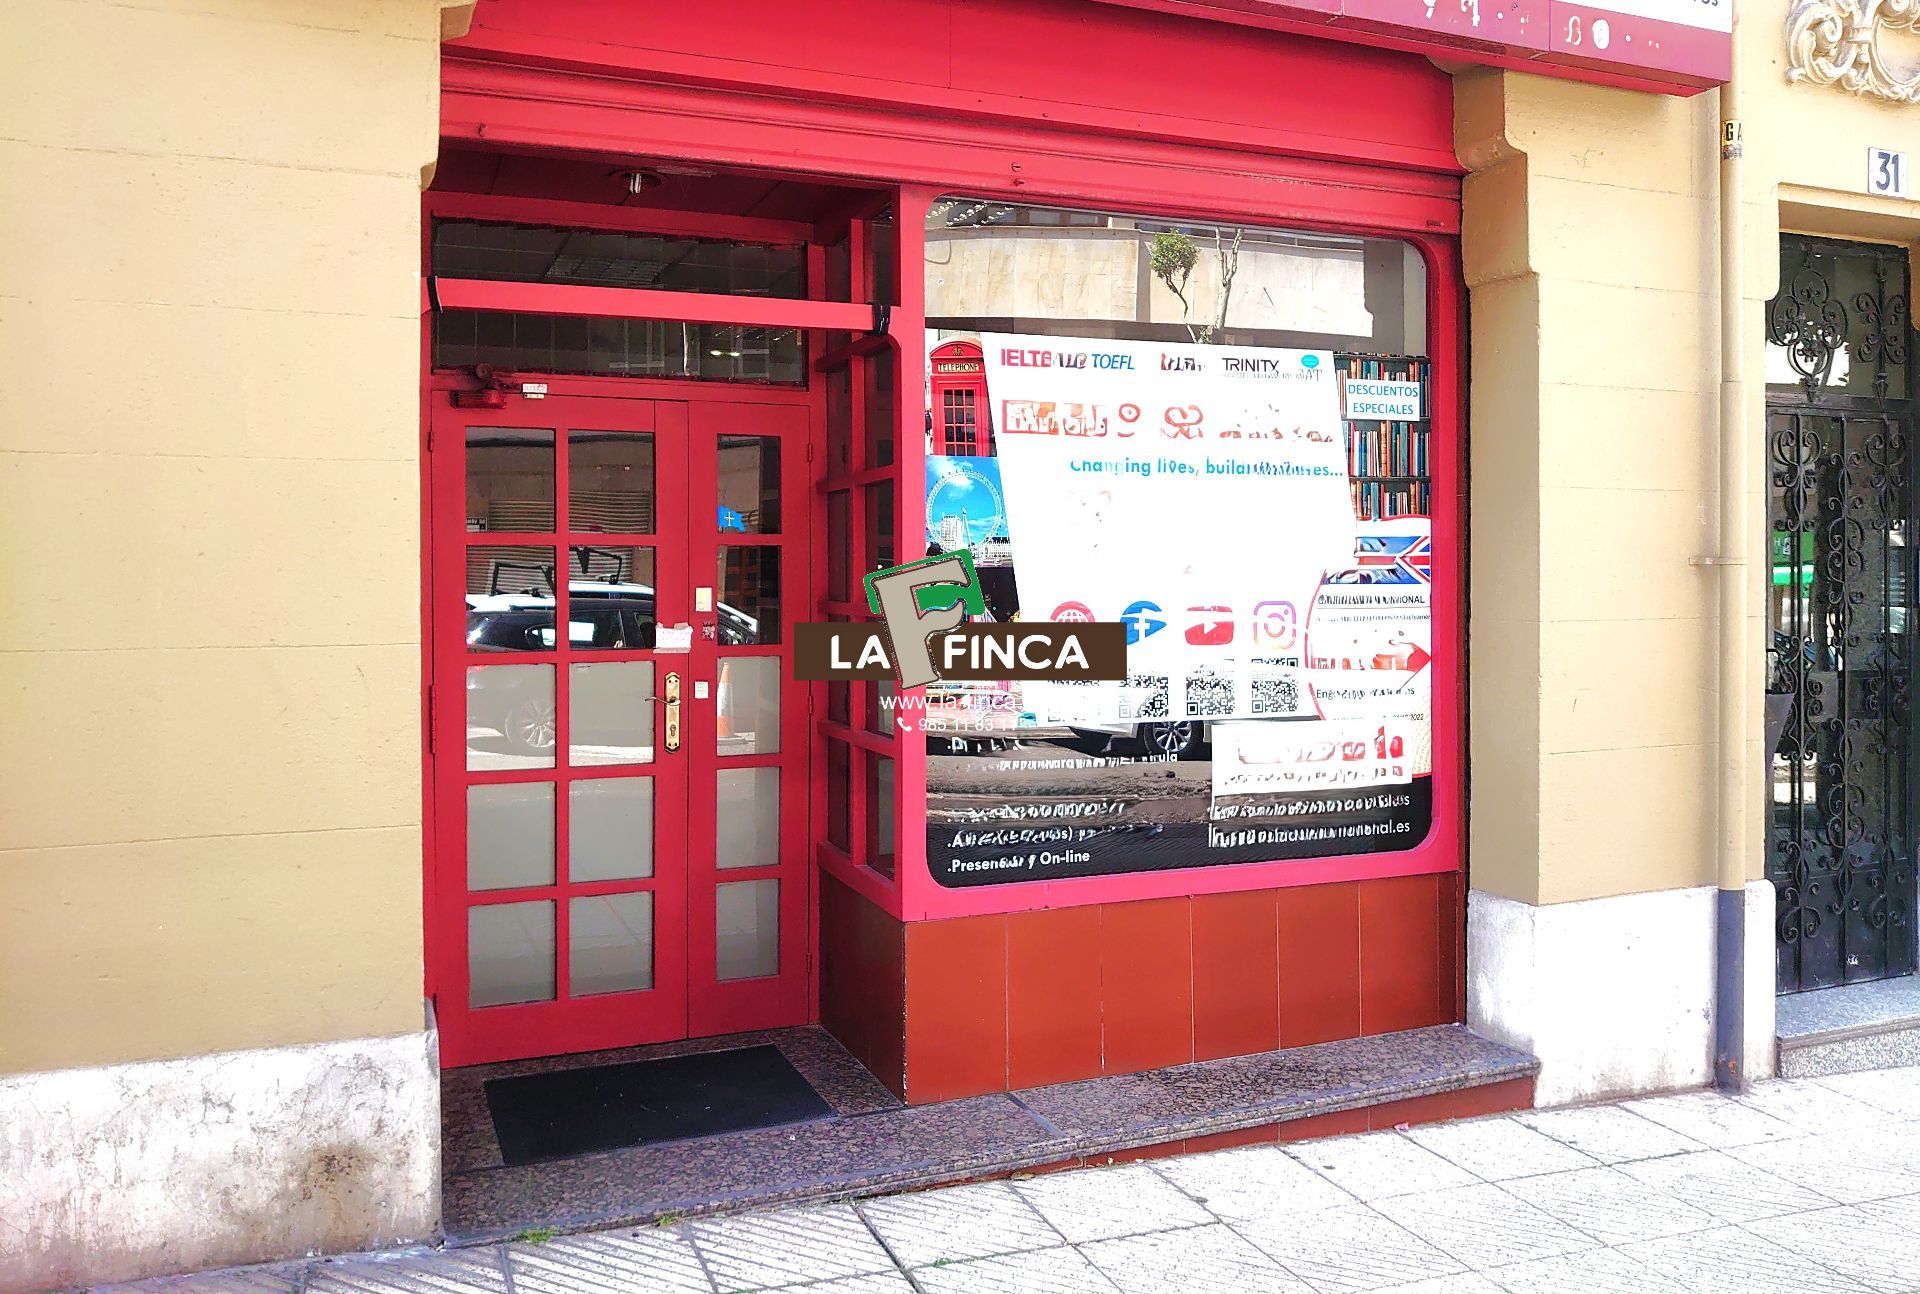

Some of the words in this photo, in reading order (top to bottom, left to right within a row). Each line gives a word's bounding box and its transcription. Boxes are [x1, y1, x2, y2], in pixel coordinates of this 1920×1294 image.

[1875, 151, 1900, 193] 31
[1091, 353, 1135, 370] TOEFL
[1221, 357, 1280, 373] TRINITY
[1348, 384, 1419, 398] DESCUENTOS
[1353, 402, 1414, 415] ESPECIALES
[1040, 850, 1091, 866] On-line
